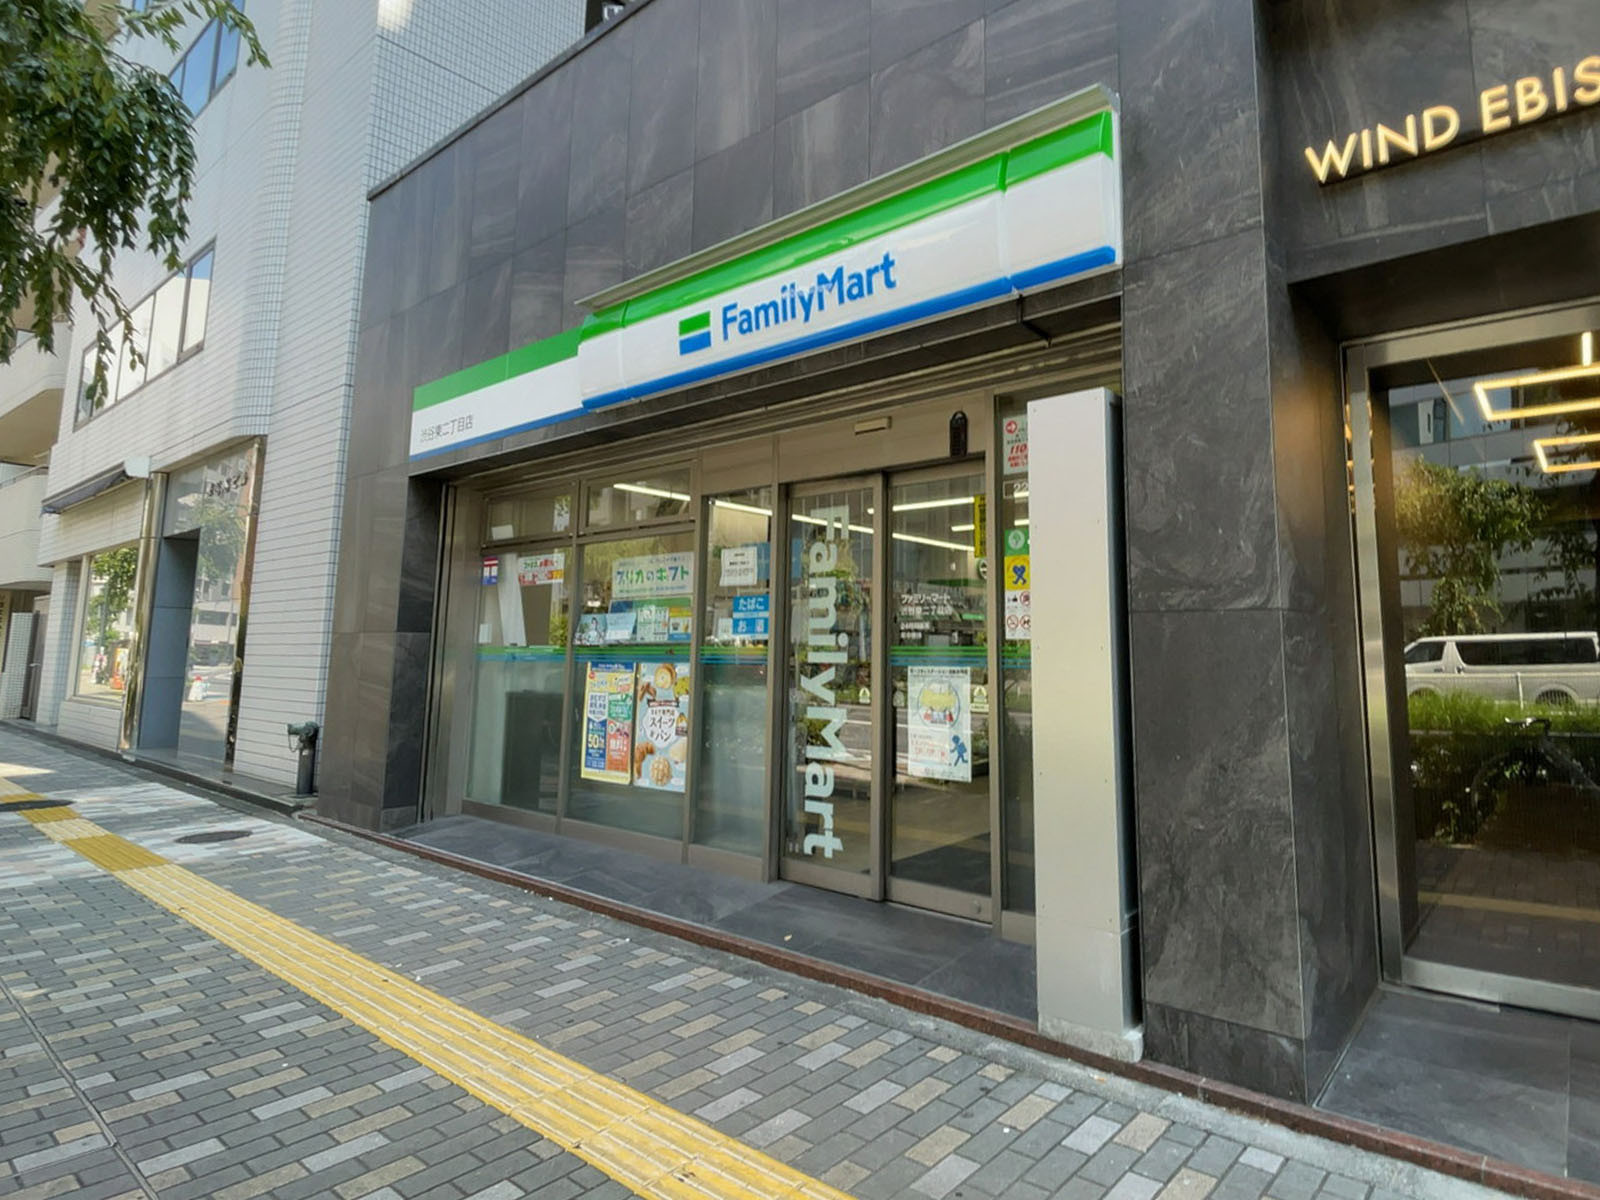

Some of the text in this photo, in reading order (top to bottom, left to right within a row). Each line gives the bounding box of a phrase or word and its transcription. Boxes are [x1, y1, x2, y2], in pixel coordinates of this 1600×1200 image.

[1304, 55, 1600, 184] WIND EBIS
[722, 252, 897, 341] FamilyMart
[738, 597, 765, 611] たばこ
[799, 504, 850, 859] FamilyMart
